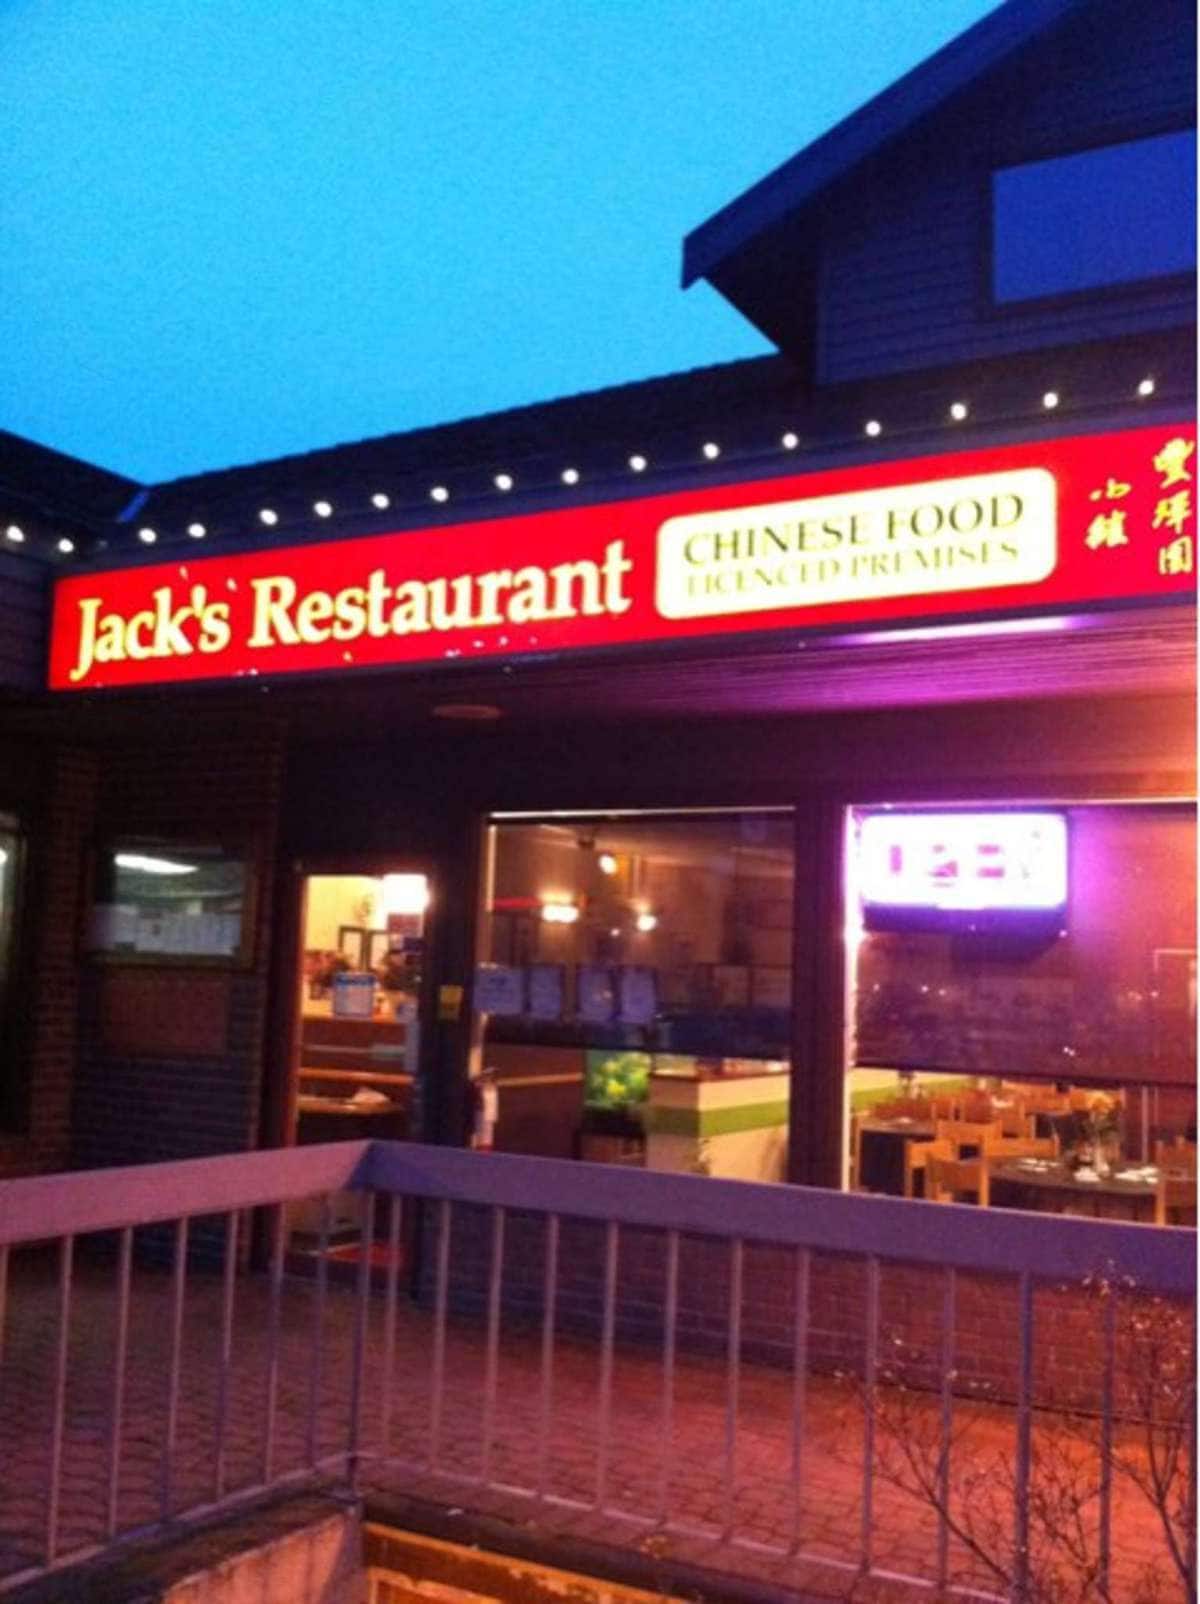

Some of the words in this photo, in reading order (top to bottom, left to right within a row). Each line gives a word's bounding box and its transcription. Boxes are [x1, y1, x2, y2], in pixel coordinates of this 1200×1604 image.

[683, 514, 871, 566] CHINESE
[886, 492, 1025, 541] FOOD
[850, 540, 1019, 578] PREMISES
[69, 584, 231, 681] Jack's
[246, 539, 633, 648] Restaurant
